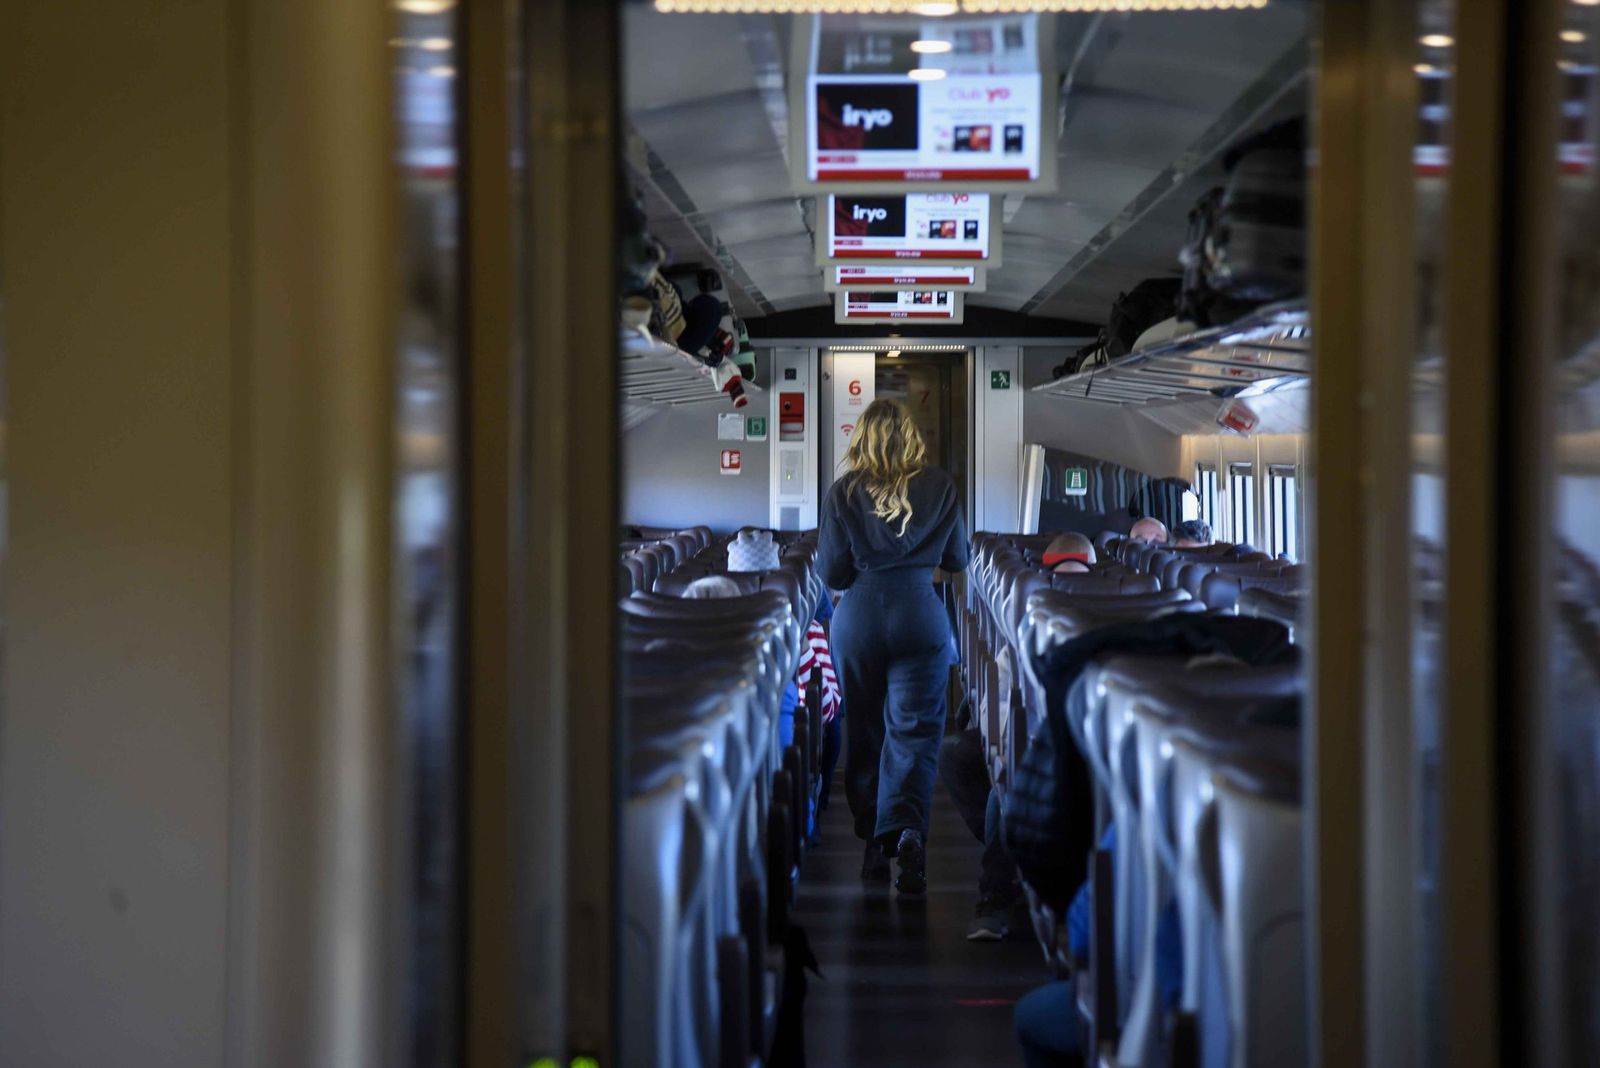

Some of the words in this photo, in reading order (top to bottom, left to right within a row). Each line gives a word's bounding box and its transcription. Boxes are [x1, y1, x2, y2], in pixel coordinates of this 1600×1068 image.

[986, 87, 1011, 103] yo
[842, 103, 893, 131] iryo
[853, 204, 887, 223] iryo
[848, 380, 862, 396] 6
